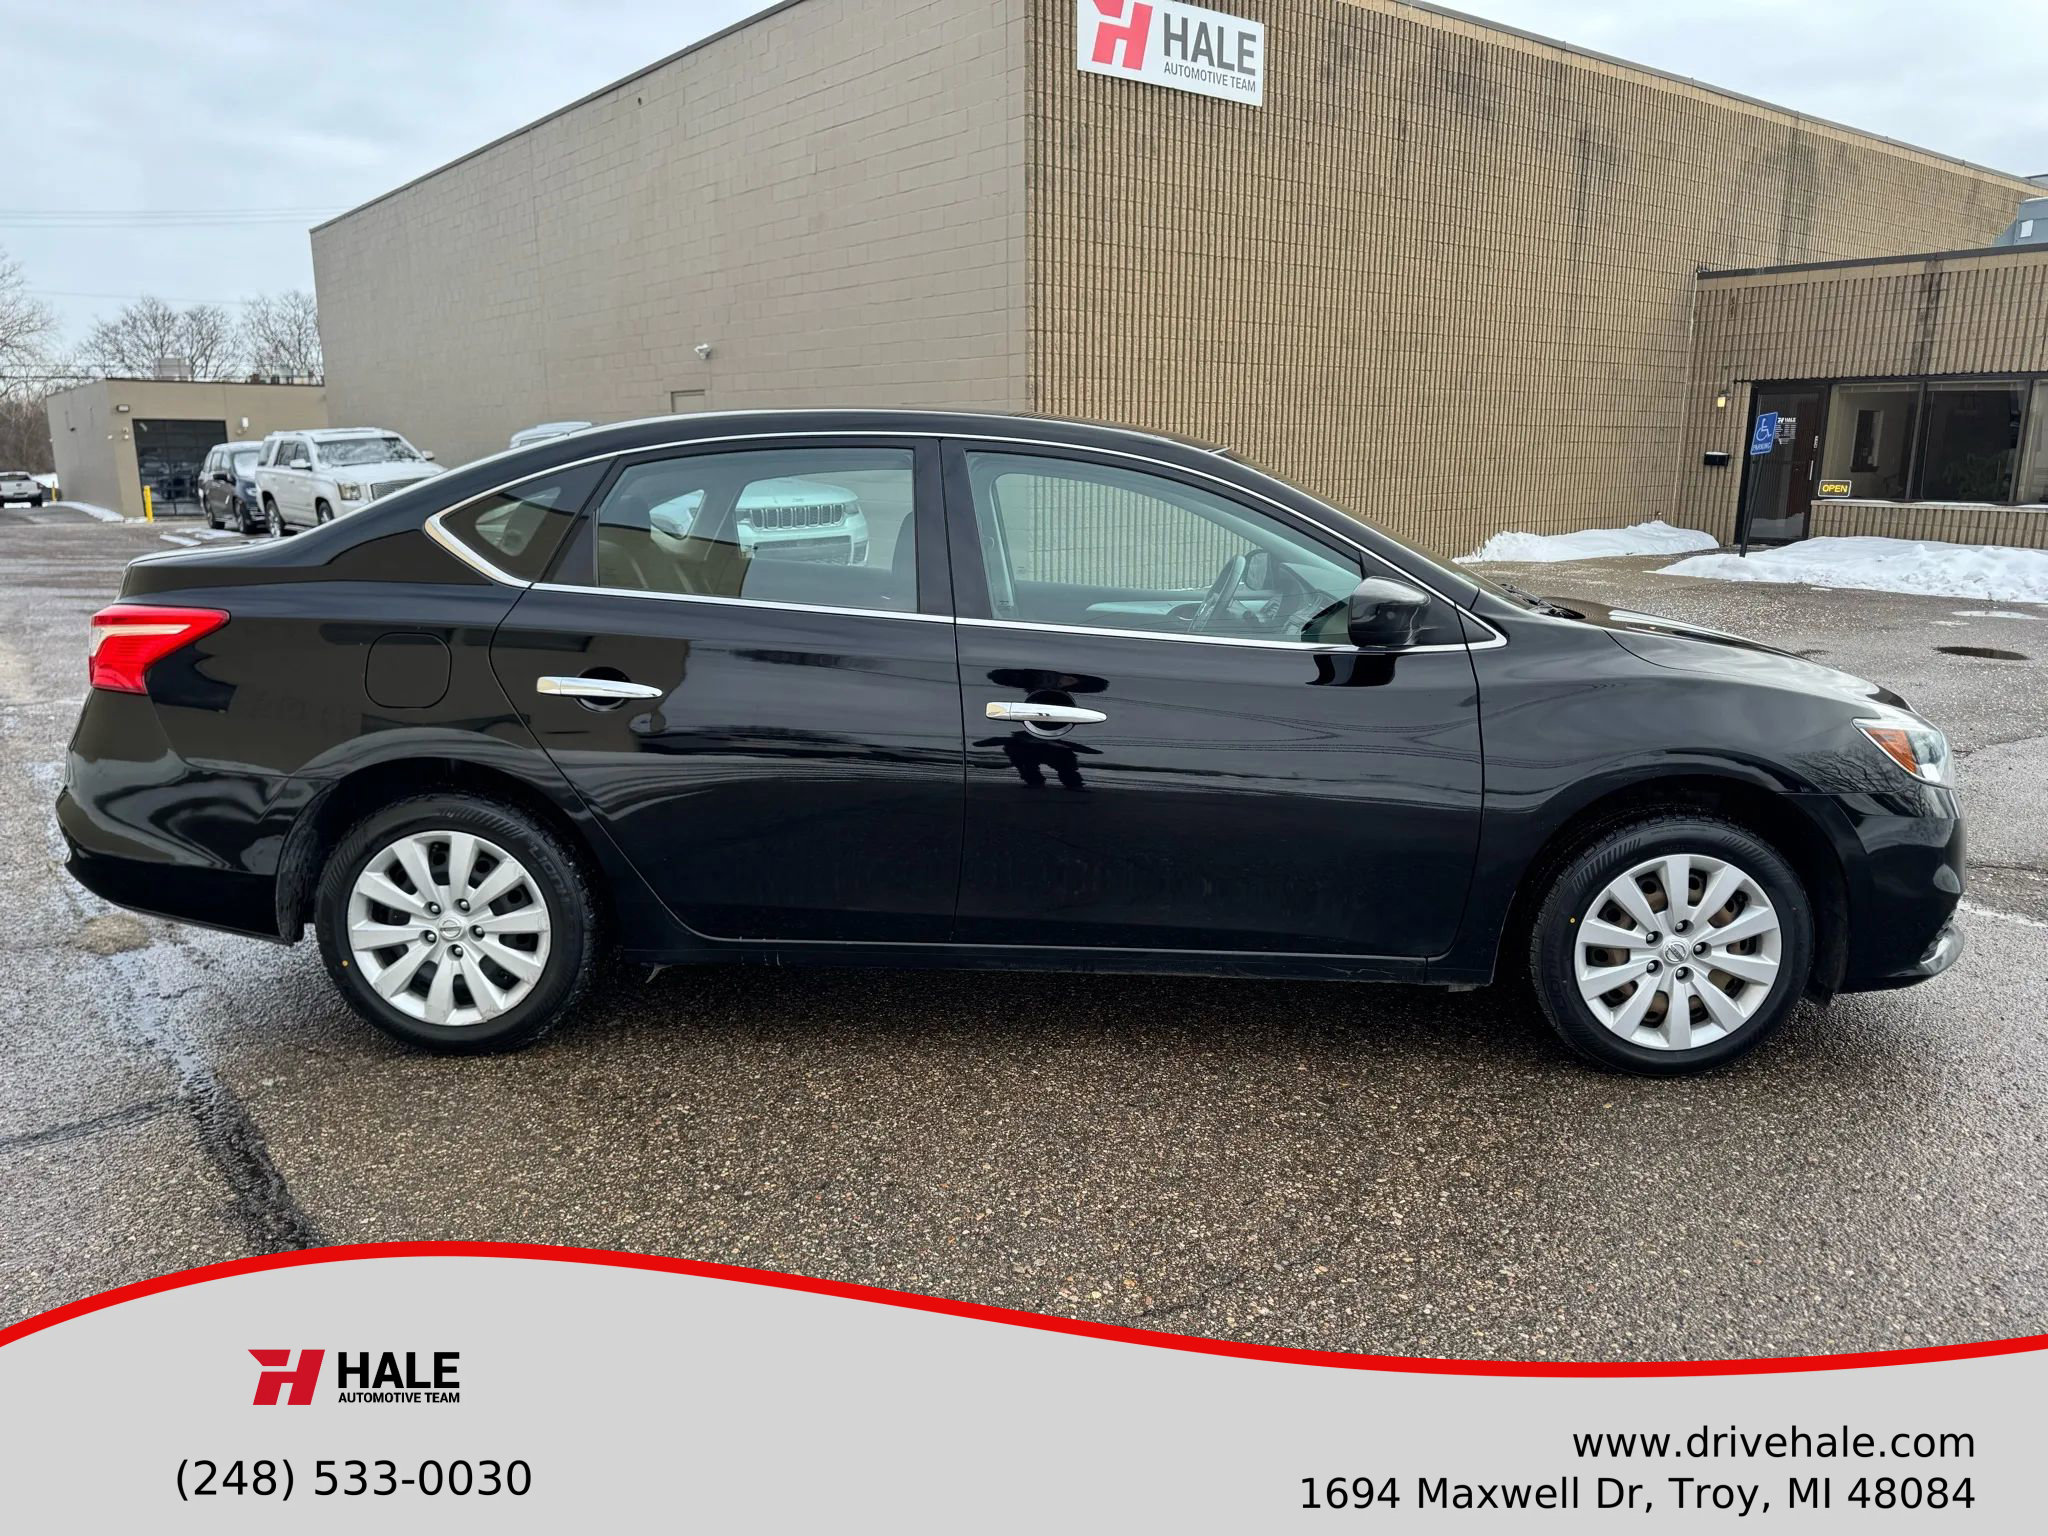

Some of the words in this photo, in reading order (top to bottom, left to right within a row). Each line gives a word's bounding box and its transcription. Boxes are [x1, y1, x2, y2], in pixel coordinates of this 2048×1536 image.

[1163, 12, 1257, 77] HALE
[1164, 61, 1229, 86] AUTOMOTIVE
[1230, 75, 1256, 93] TEAM
[1822, 484, 1848, 493] OPEN
